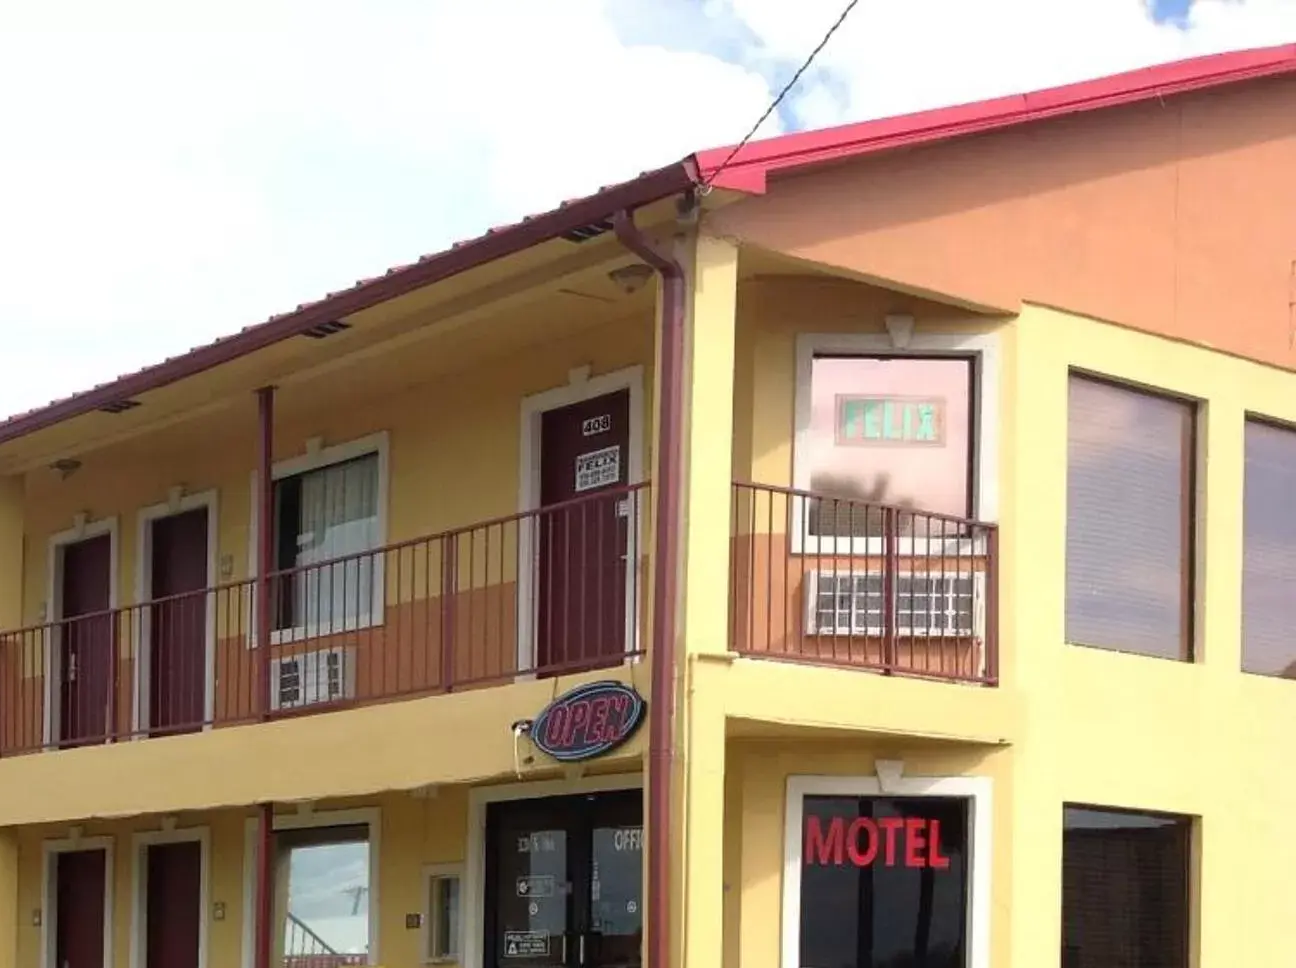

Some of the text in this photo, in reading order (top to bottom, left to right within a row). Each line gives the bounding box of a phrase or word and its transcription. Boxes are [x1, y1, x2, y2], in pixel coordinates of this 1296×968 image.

[842, 399, 936, 440] FELIX
[544, 694, 630, 748] OPEN
[806, 814, 950, 869] MOTEL
